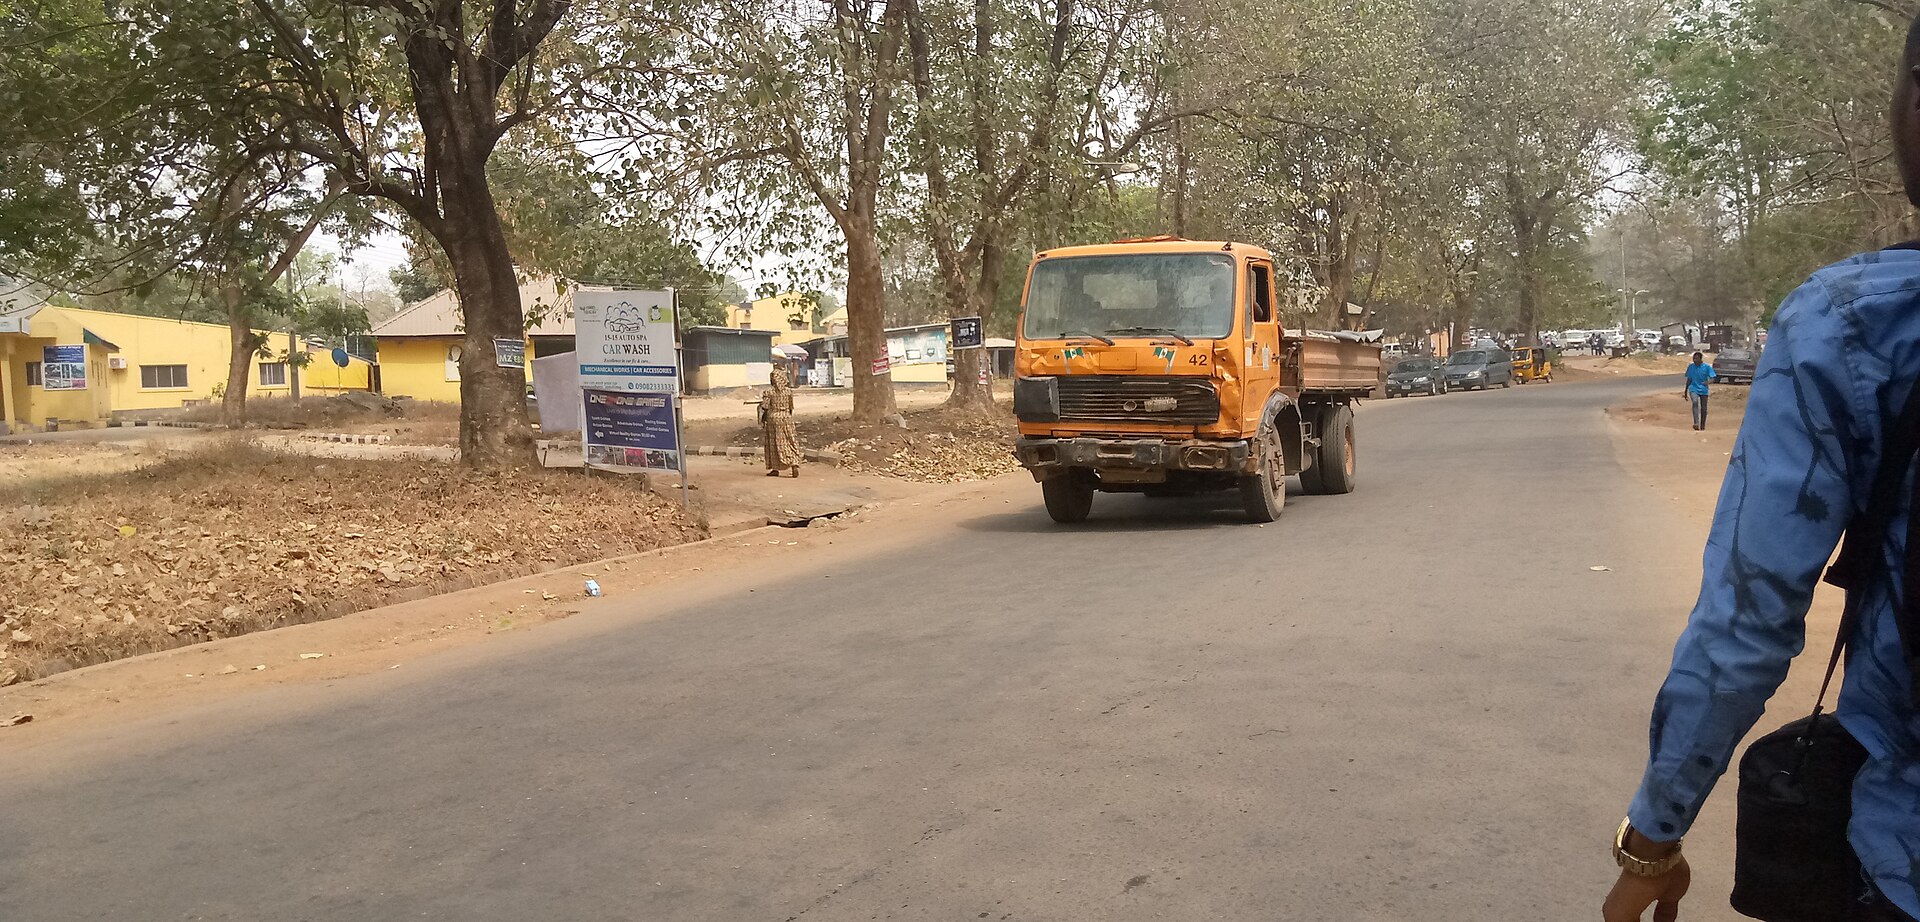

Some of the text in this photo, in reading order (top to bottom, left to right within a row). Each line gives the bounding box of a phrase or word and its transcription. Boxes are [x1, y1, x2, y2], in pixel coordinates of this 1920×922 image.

[602, 344, 651, 355] CAR WASH
[1188, 354, 1208, 366] 42
[590, 394, 607, 404] ONE
[616, 396, 634, 405] ONE
[636, 398, 665, 408] GAMES
